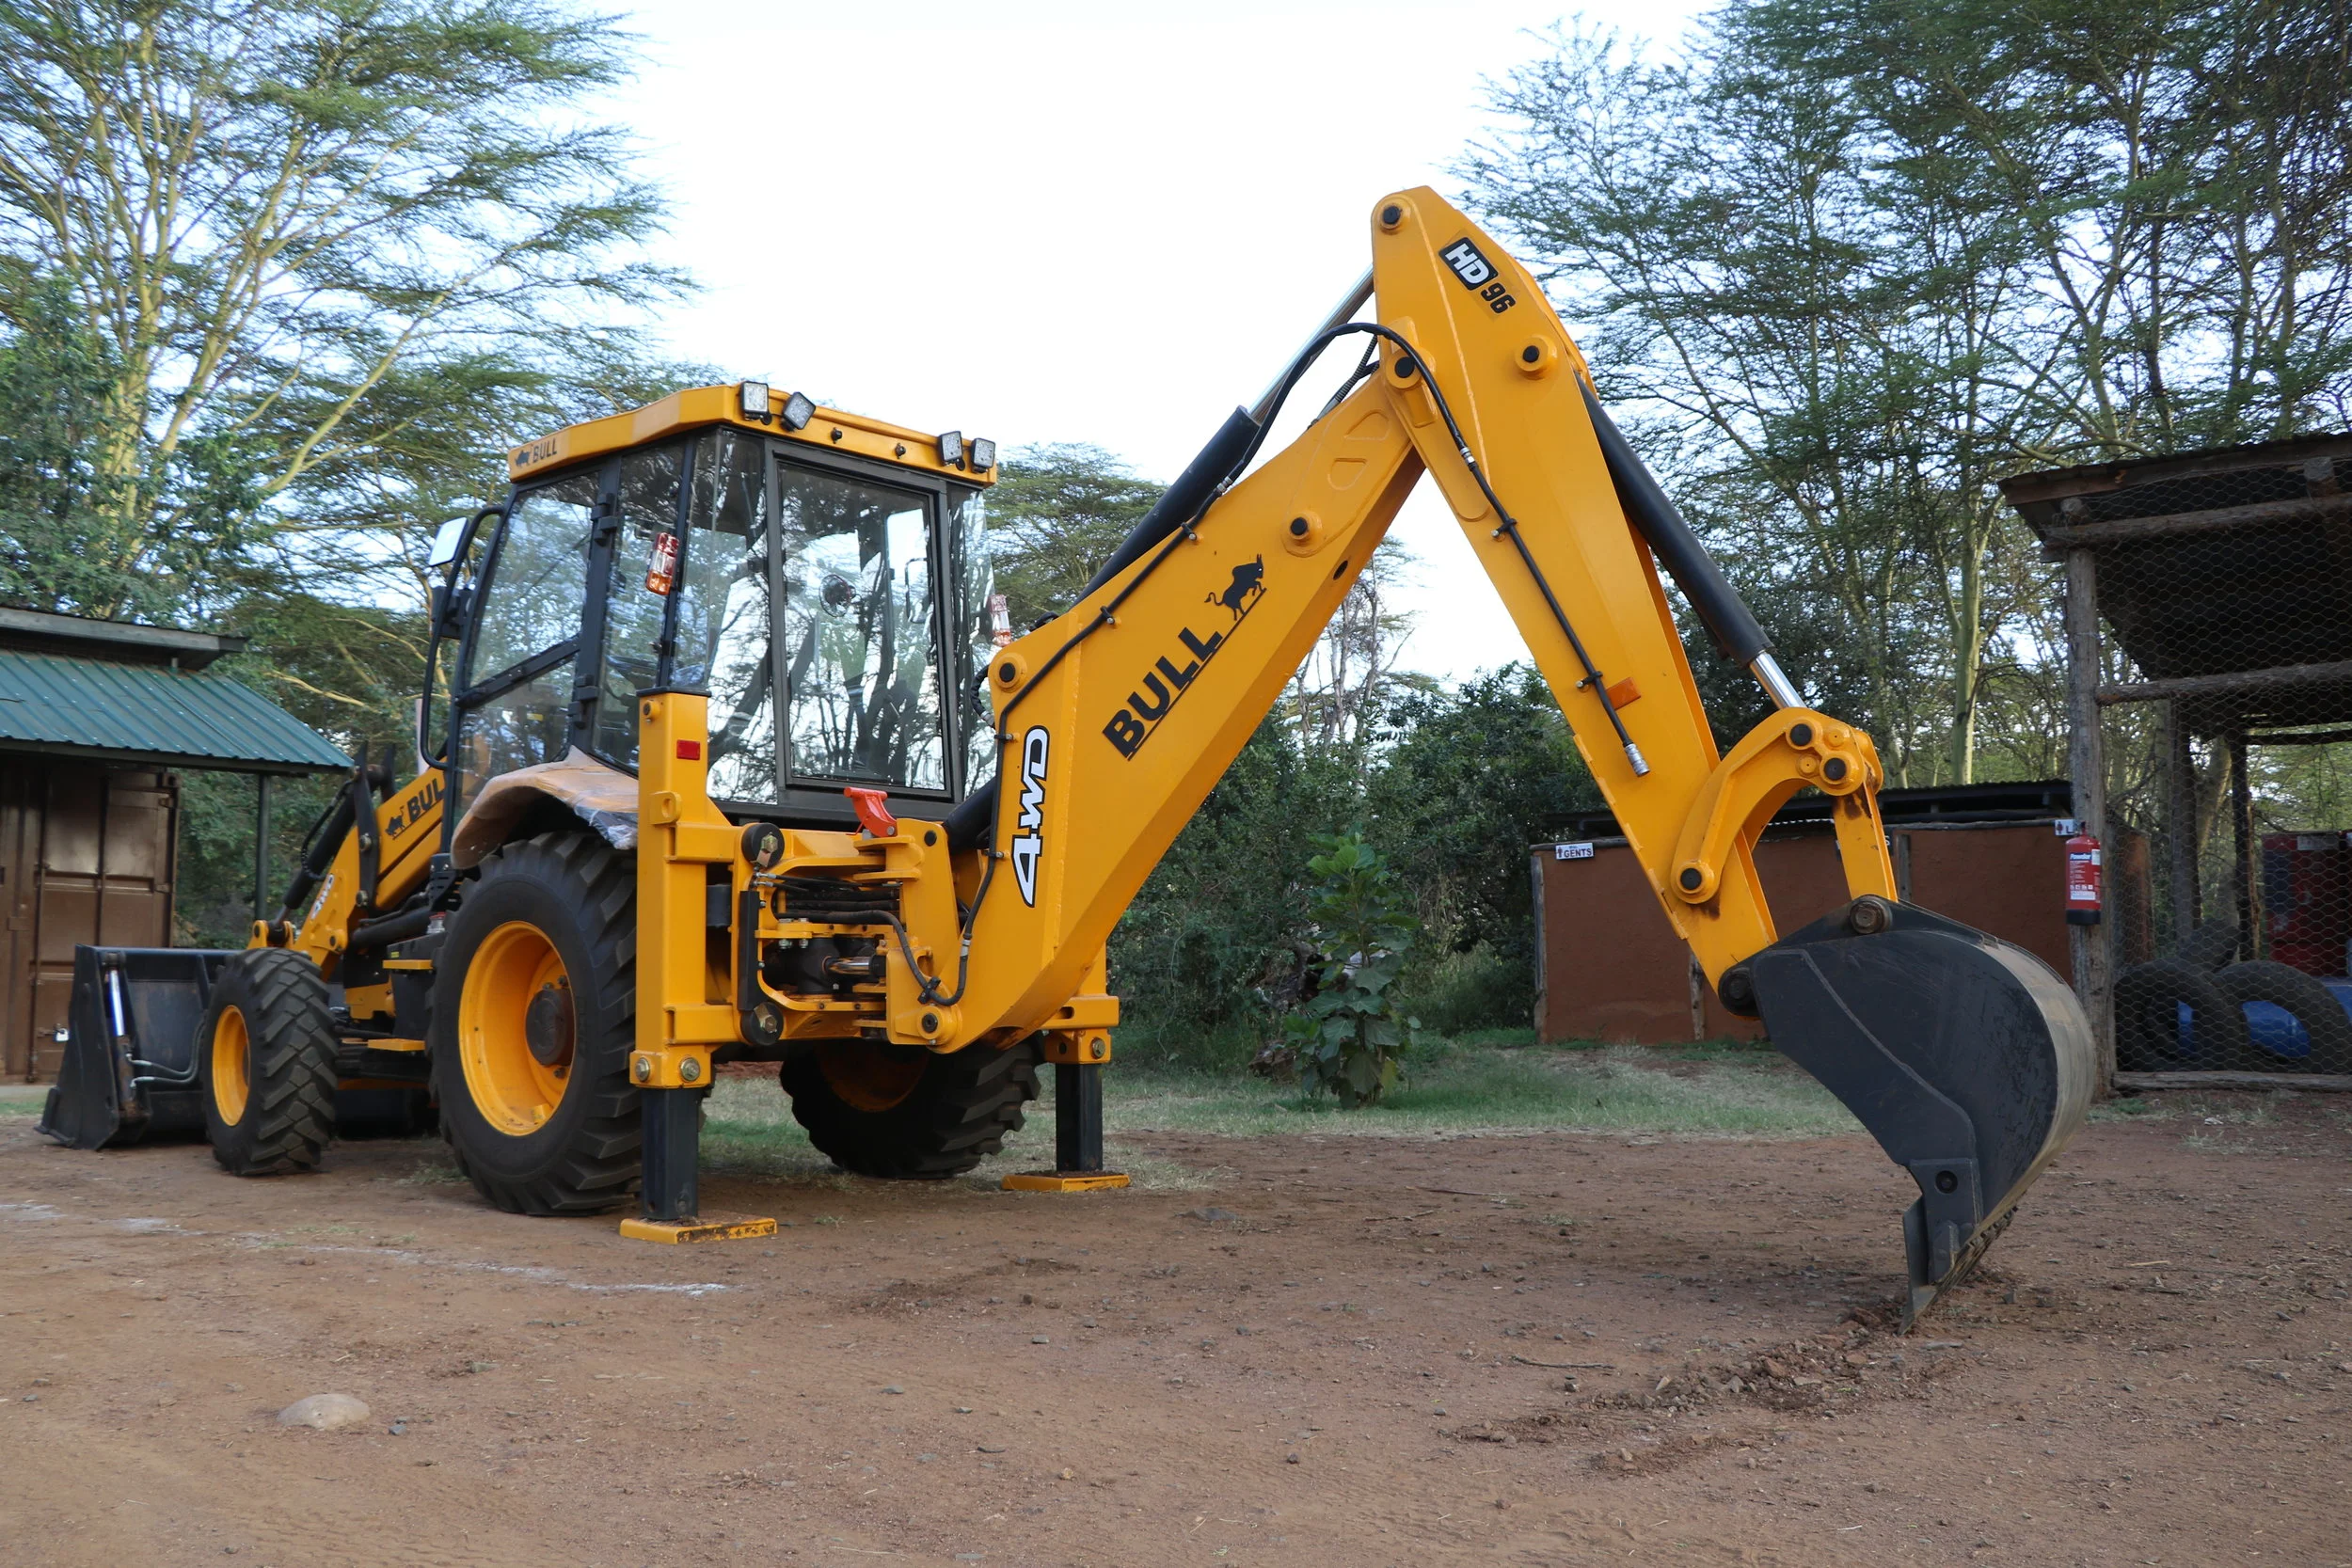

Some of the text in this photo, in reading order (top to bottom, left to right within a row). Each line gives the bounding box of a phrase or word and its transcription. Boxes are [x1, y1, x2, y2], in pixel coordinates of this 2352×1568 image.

[1444, 243, 1516, 313] HD 96
[532, 437, 557, 463] BULL
[1102, 626, 1223, 759] BULL
[407, 778, 444, 823] BUL
[1011, 725, 1050, 908] 4WD
[1564, 847, 1592, 858] GENTS
